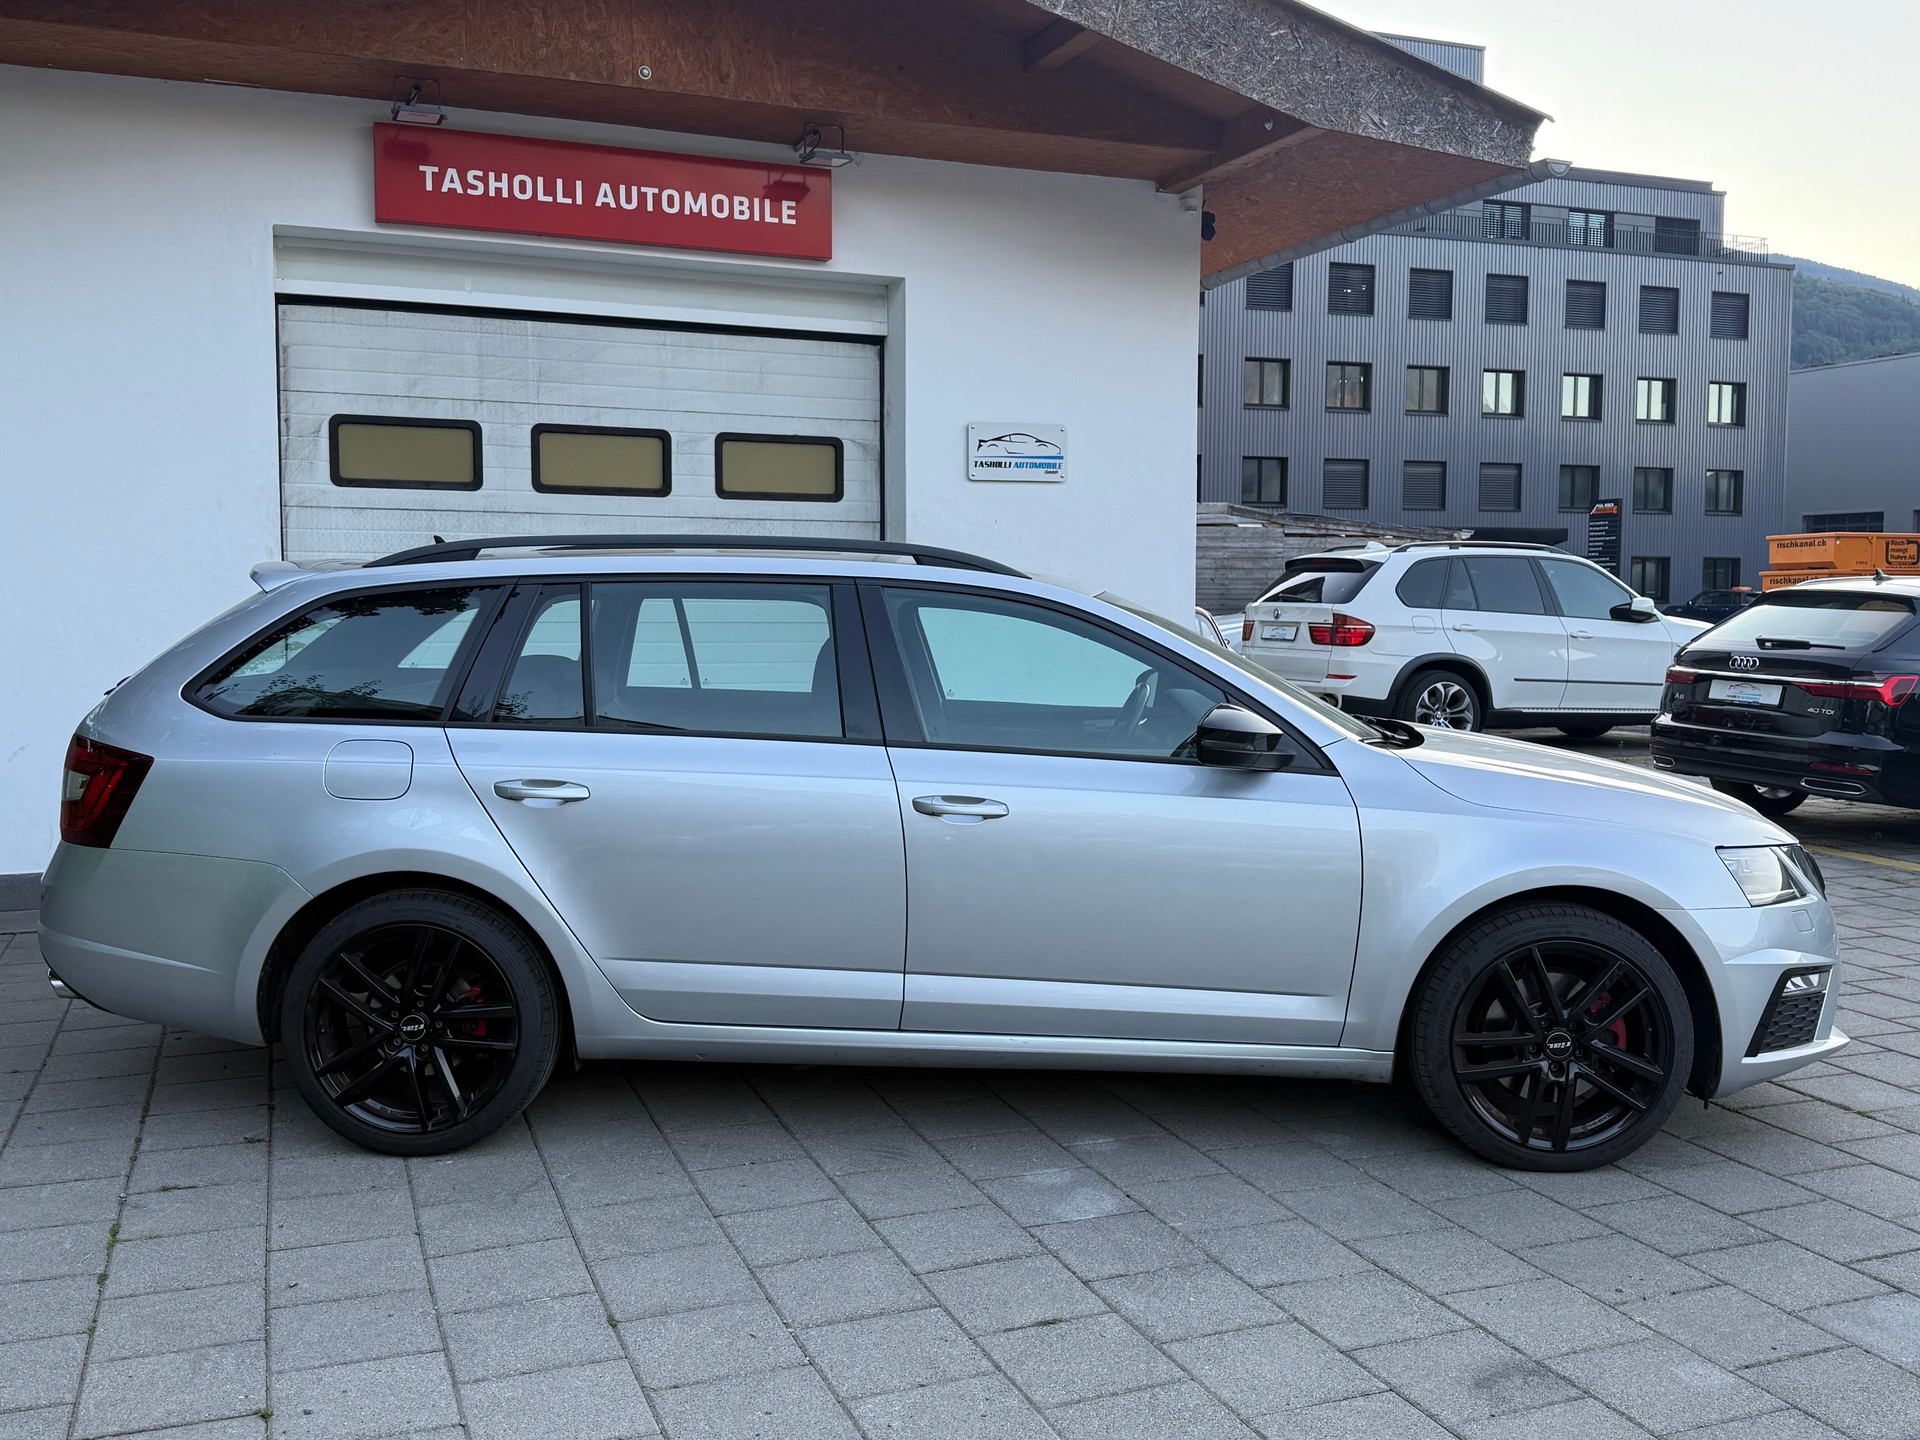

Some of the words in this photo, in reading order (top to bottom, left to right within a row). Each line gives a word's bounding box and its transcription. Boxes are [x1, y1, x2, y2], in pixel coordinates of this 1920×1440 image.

[418, 164, 583, 206] TASHOLLI
[595, 182, 797, 225] AUTOMOBILE
[974, 461, 1012, 469] TASHOLLI
[1013, 462, 1063, 470] AUTOMOBILE
[1777, 539, 1827, 549] rischkanal.ch
